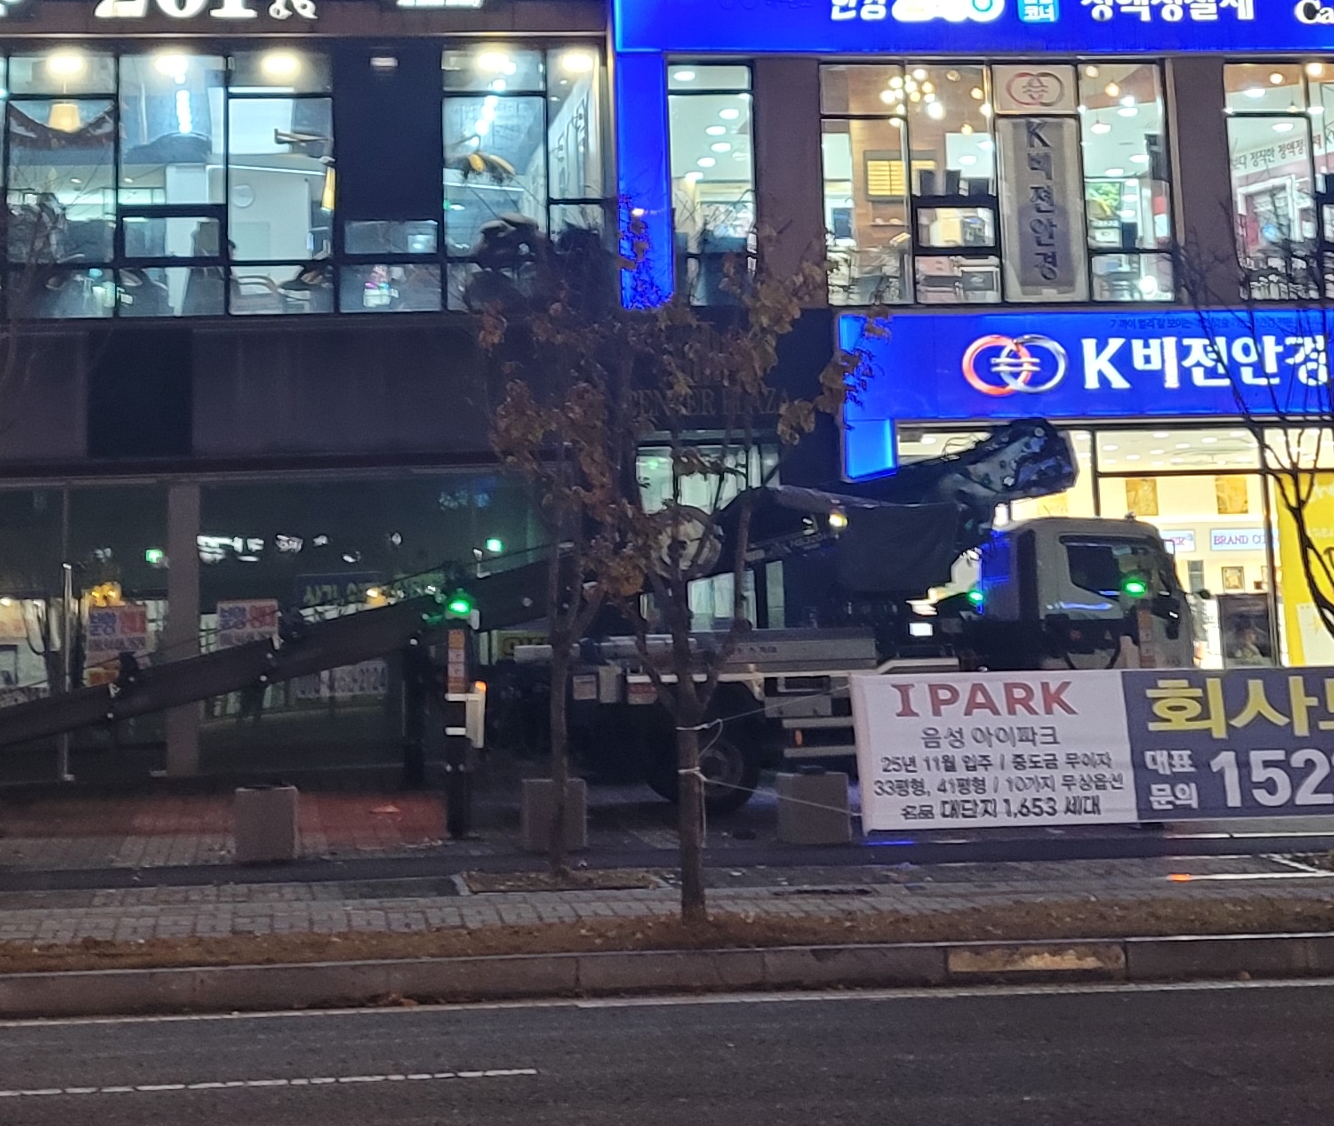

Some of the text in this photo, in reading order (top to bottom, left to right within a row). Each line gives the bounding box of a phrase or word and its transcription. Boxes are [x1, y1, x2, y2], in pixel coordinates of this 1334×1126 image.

[1080, 335, 1330, 390] K비전안경
[1213, 535, 1249, 546] BRAND
[920, 725, 1061, 749] 음성 아이파크
[880, 756, 917, 773] 25년
[923, 754, 957, 772] 11월
[962, 754, 994, 772] 입주
[1011, 753, 1059, 771] 중도금
[1064, 751, 1113, 770] 무이자
[1143, 749, 1197, 775] 대표
[873, 777, 931, 797] 33평형,
[936, 776, 988, 795] 41평형
[1005, 775, 1056, 793] 10가지
[1060, 773, 1125, 791] 무상옵션
[1148, 782, 1199, 811] 문의
[939, 798, 998, 819] 대단지
[1002, 797, 1058, 818] 1,653
[1063, 795, 1102, 816] 세대
